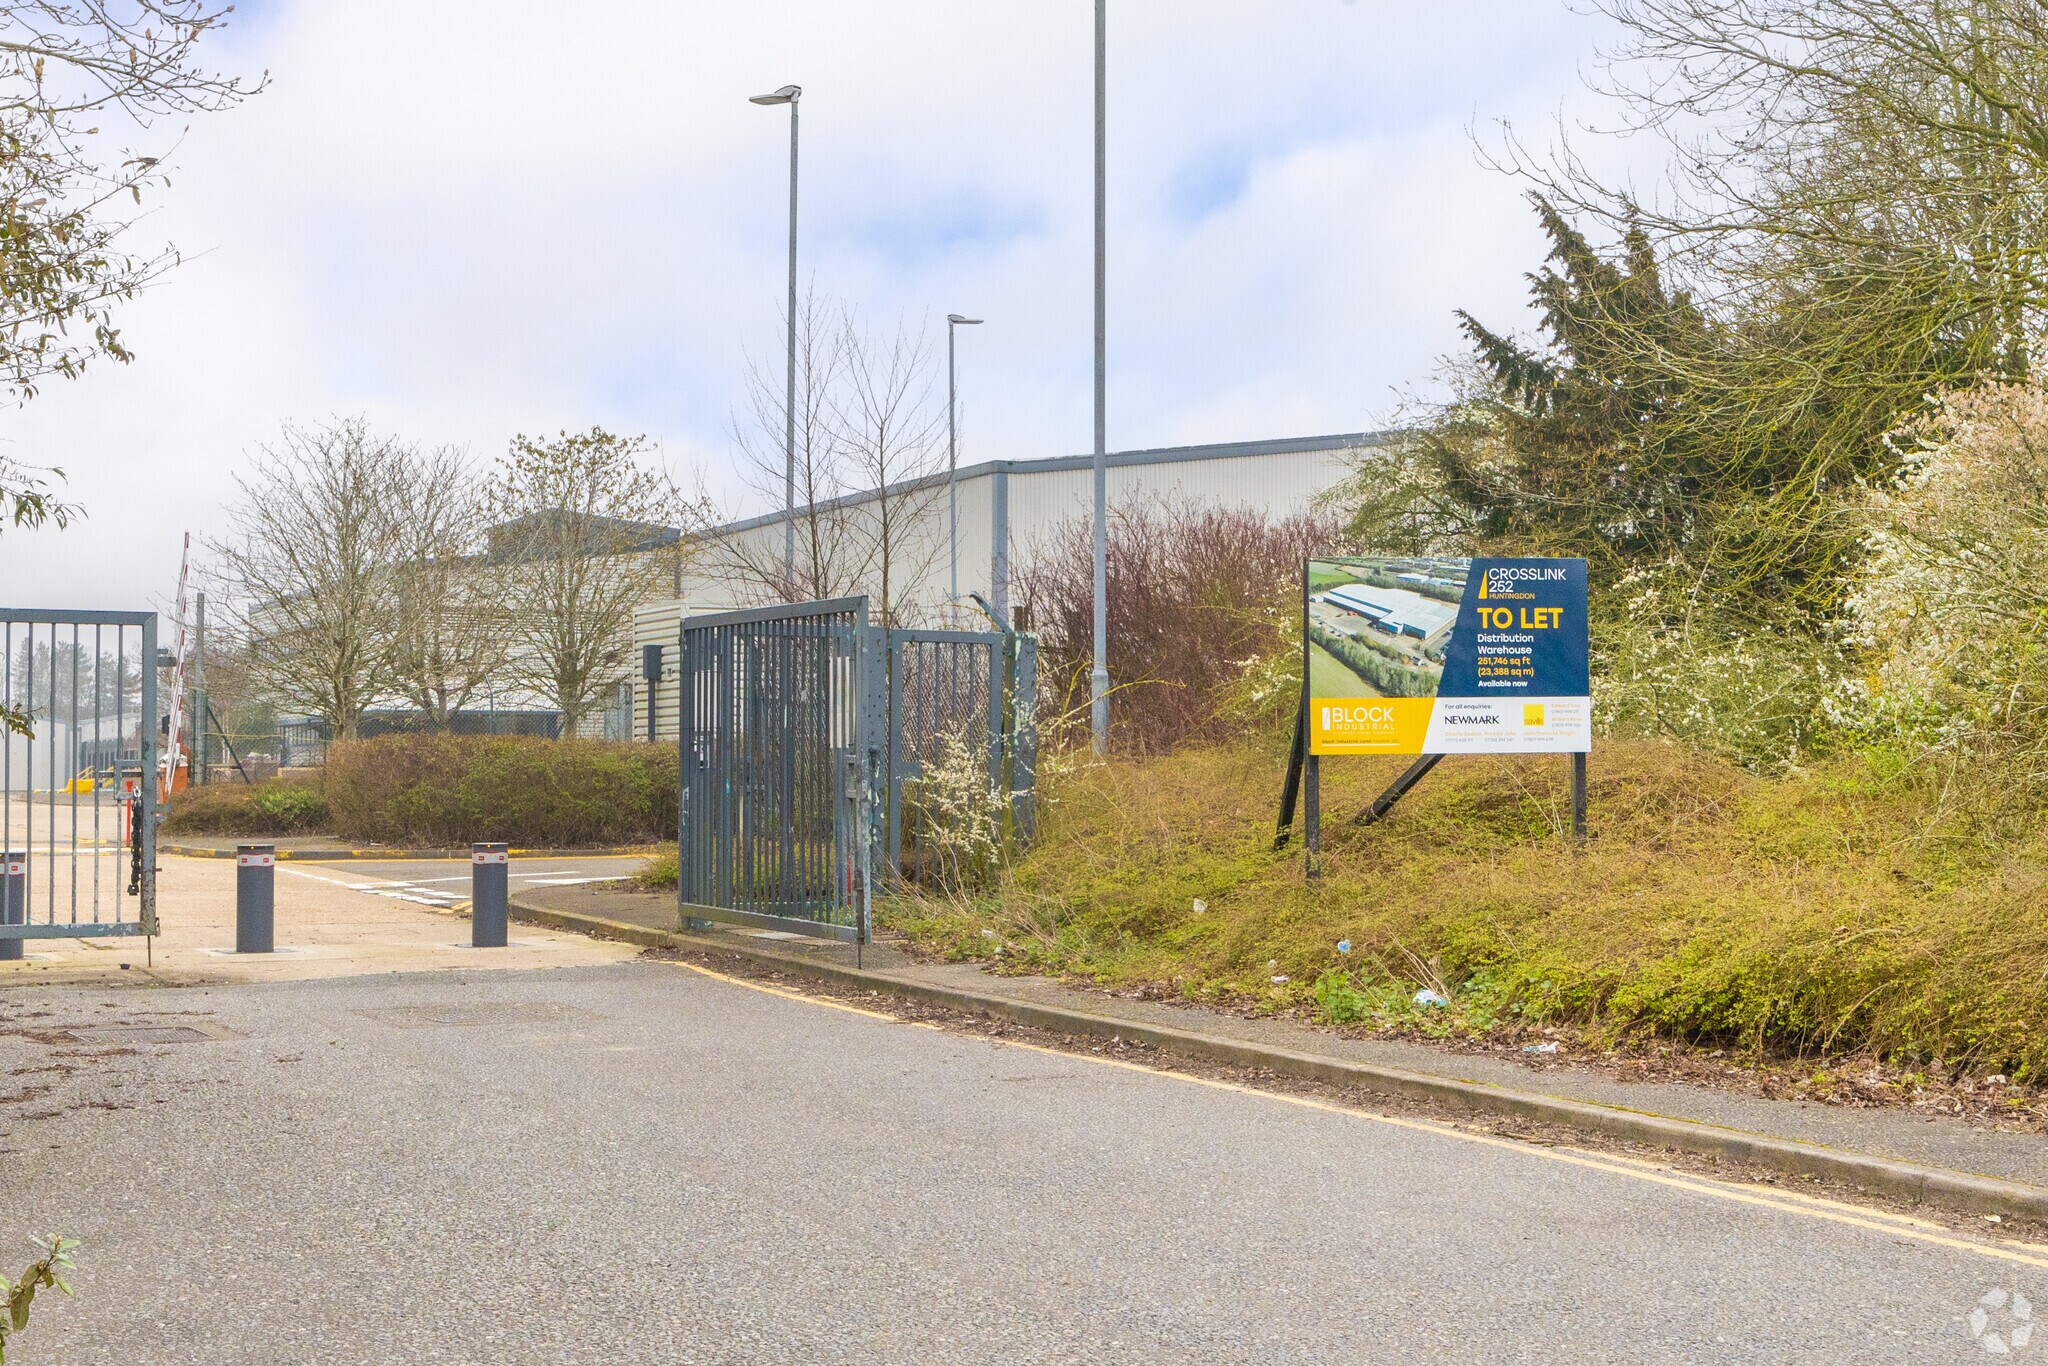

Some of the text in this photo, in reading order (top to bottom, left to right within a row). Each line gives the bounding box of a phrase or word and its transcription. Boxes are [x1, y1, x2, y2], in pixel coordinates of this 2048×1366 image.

[1488, 568, 1567, 580] CROSSLINK
[1488, 581, 1514, 592] 252
[1477, 607, 1564, 629] TO LET
[1477, 633, 1534, 643] Distribution
[1477, 646, 1533, 655] Warehouse
[1477, 656, 1531, 667] 251,746 sq ft
[1477, 667, 1534, 677] (23,388 sq m)
[1478, 679, 1511, 687] Available
[1464, 703, 1493, 711] enquiries:
[1332, 707, 1394, 722] BLOCK
[1444, 715, 1500, 725] NEWMARK
[1332, 723, 1395, 731] INDUSTRIAL
